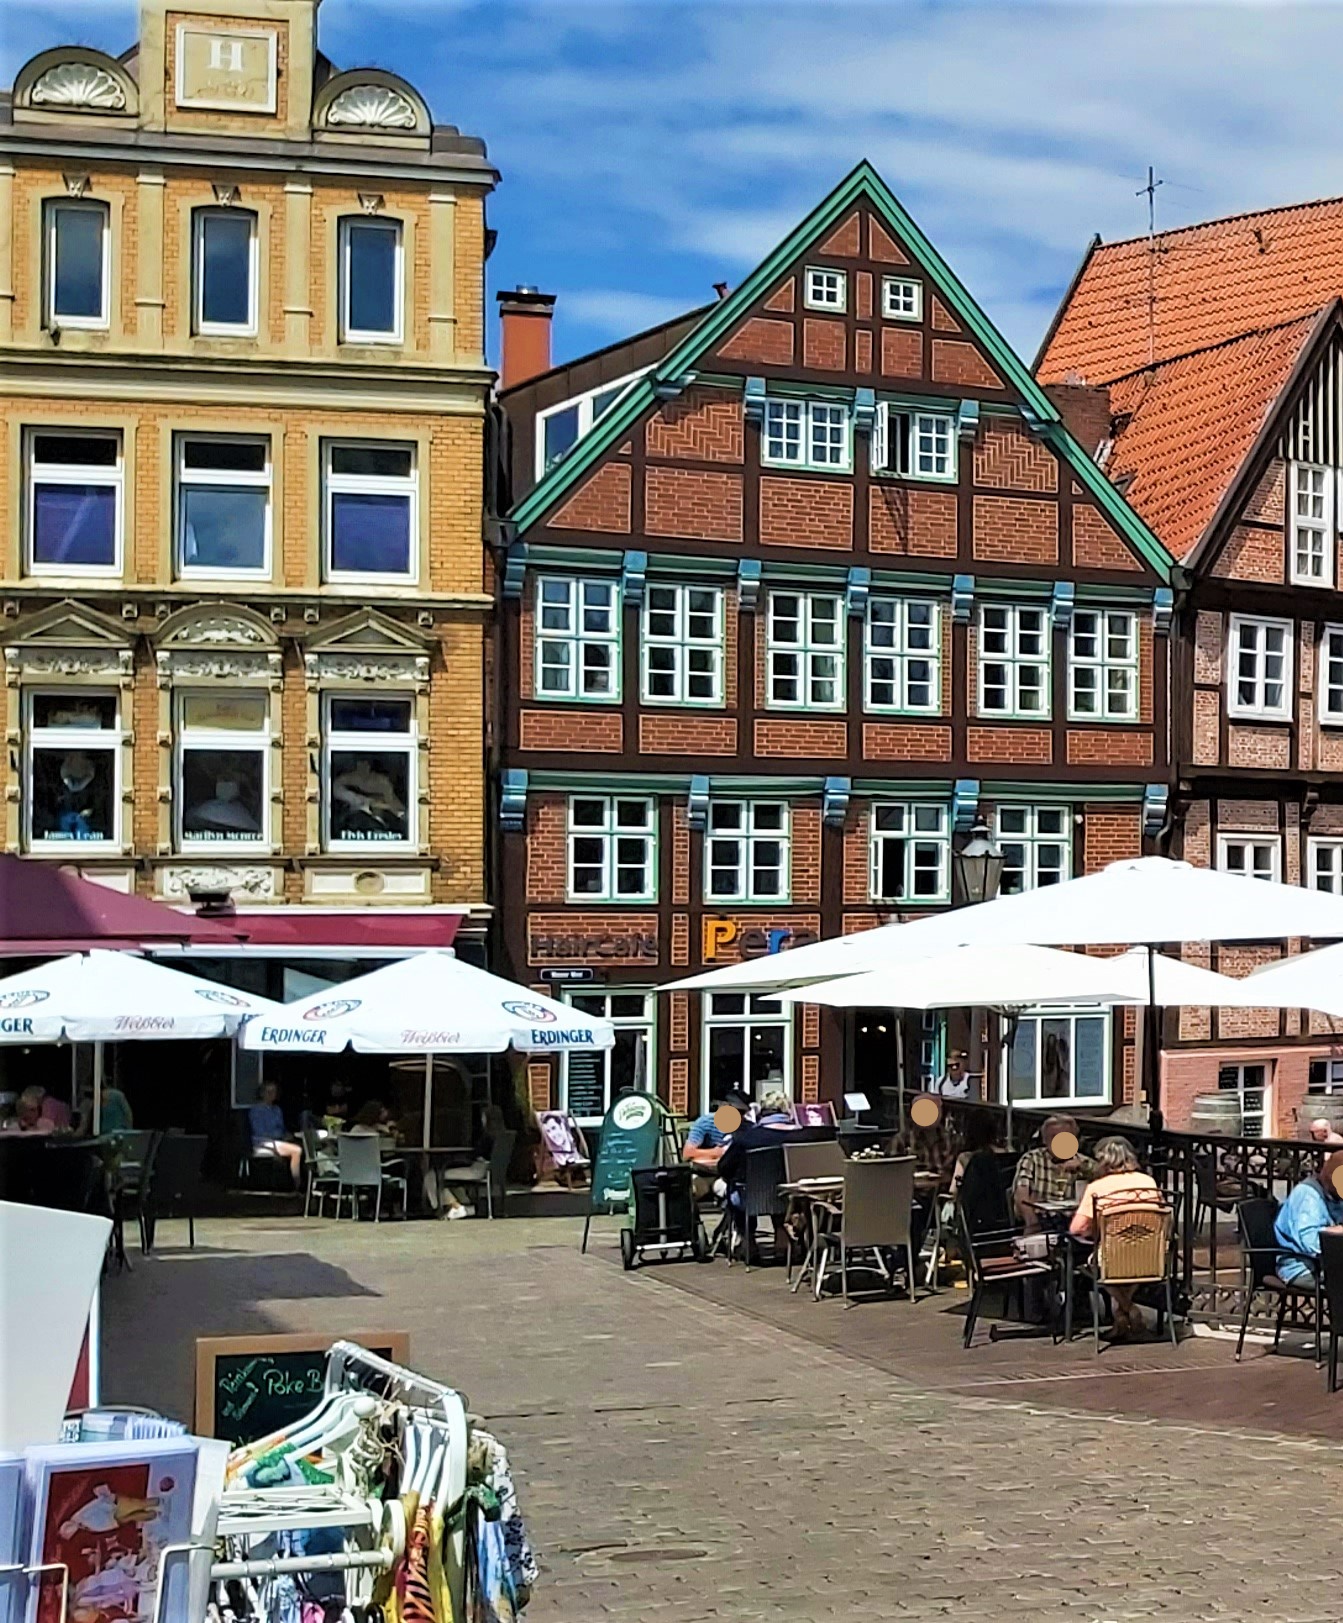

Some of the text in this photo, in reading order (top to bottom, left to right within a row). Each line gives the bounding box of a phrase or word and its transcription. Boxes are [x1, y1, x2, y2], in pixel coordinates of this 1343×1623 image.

[208, 39, 243, 72] H
[261, 1026, 327, 1046] ERDINGER
[531, 1028, 594, 1046] ERDINGER
[263, 1369, 305, 1395] Poke
